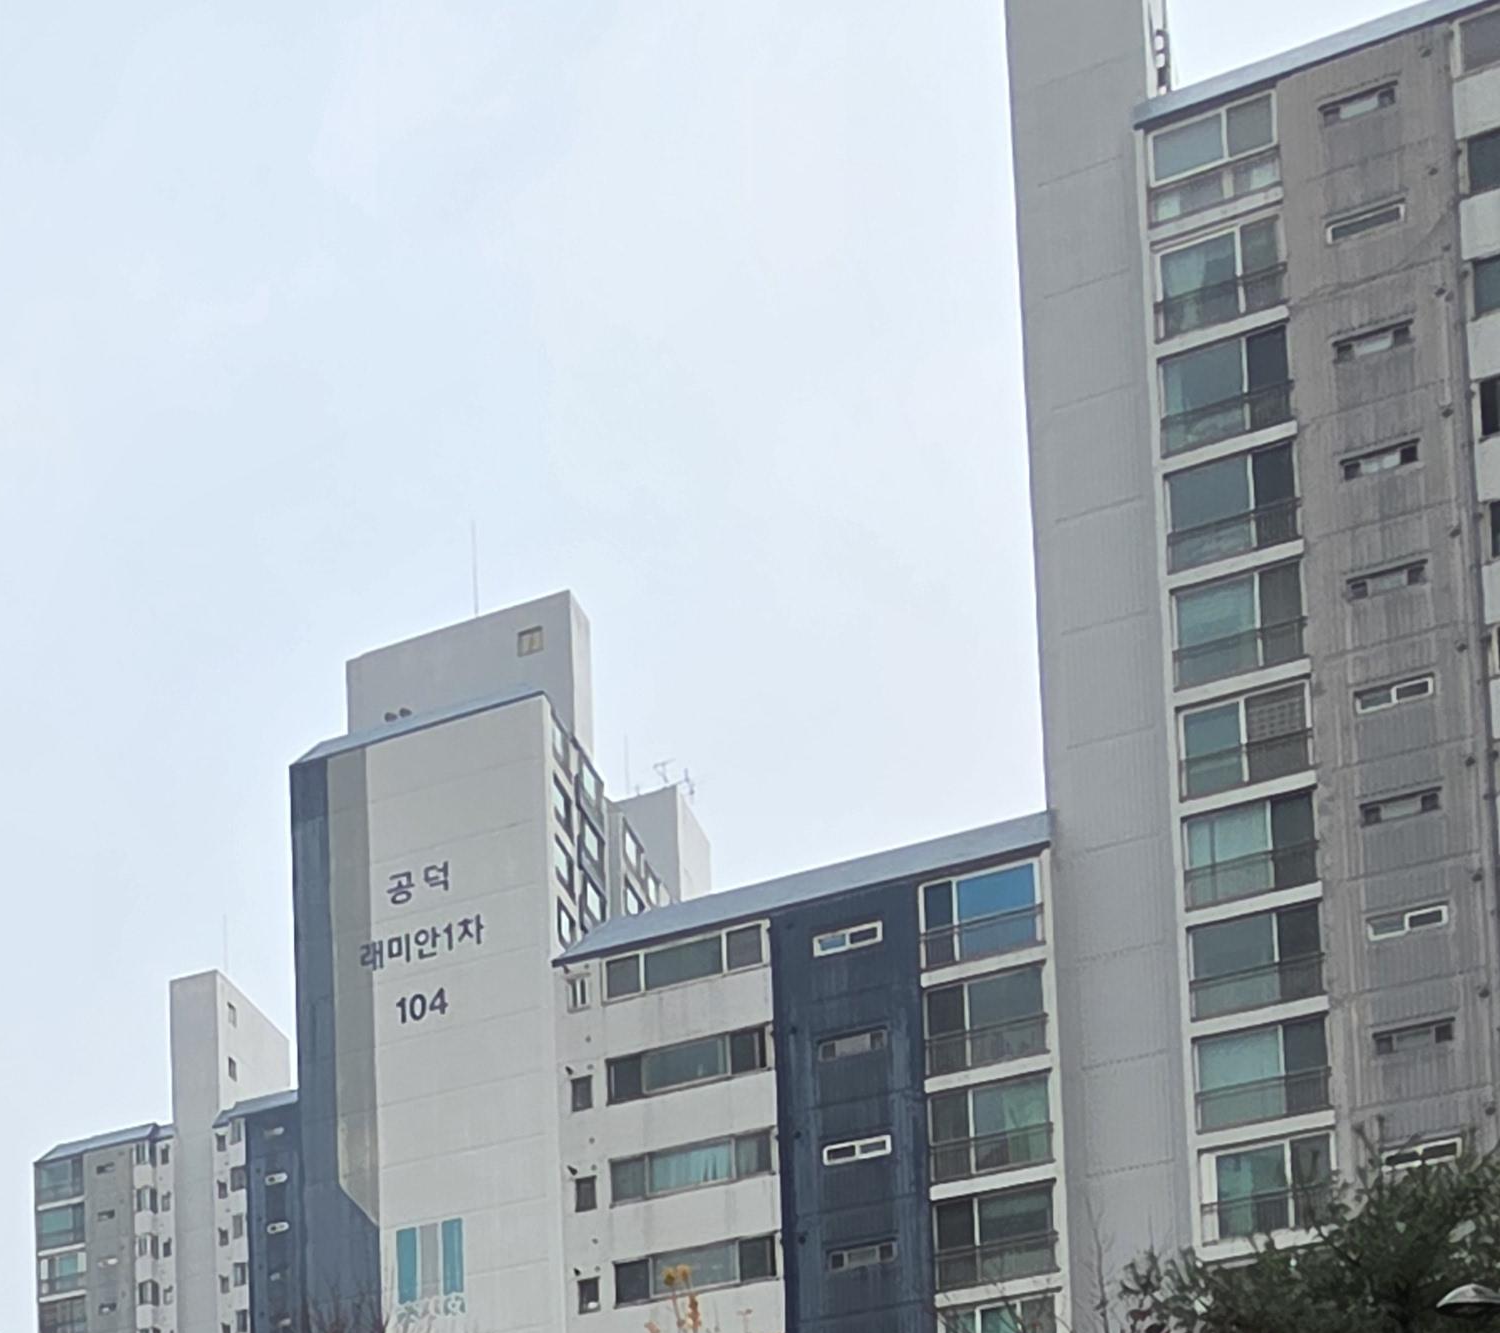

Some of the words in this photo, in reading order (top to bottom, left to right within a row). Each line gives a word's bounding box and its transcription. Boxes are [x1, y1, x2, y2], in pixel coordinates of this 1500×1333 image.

[386, 861, 449, 905] 공덕
[360, 913, 485, 971] 래미안1차
[395, 987, 449, 1024] 104
